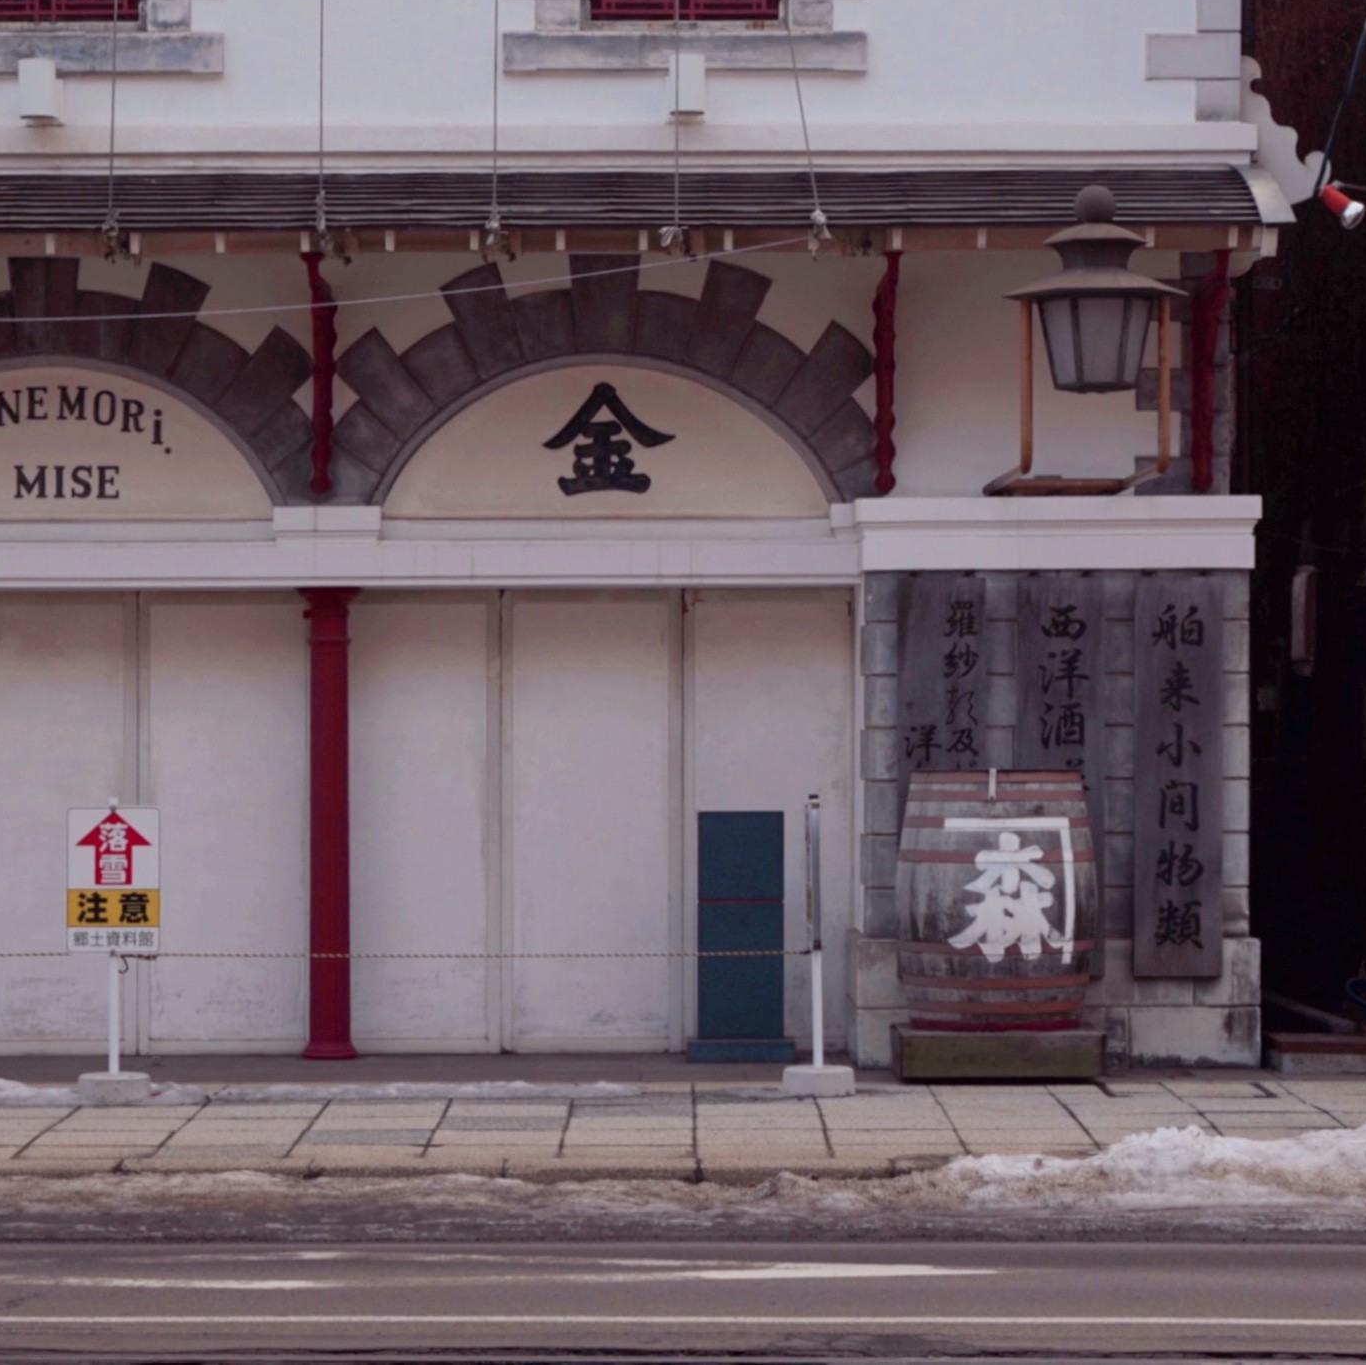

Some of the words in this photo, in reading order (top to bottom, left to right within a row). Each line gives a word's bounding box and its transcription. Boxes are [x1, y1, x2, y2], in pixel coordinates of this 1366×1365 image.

[541, 381, 677, 497] 金
[13, 465, 120, 499] MISE
[99, 822, 128, 884] 落雪
[78, 892, 149, 923] 注意
[947, 832, 1065, 963] 森
[73, 931, 153, 947] 郷土資料館
